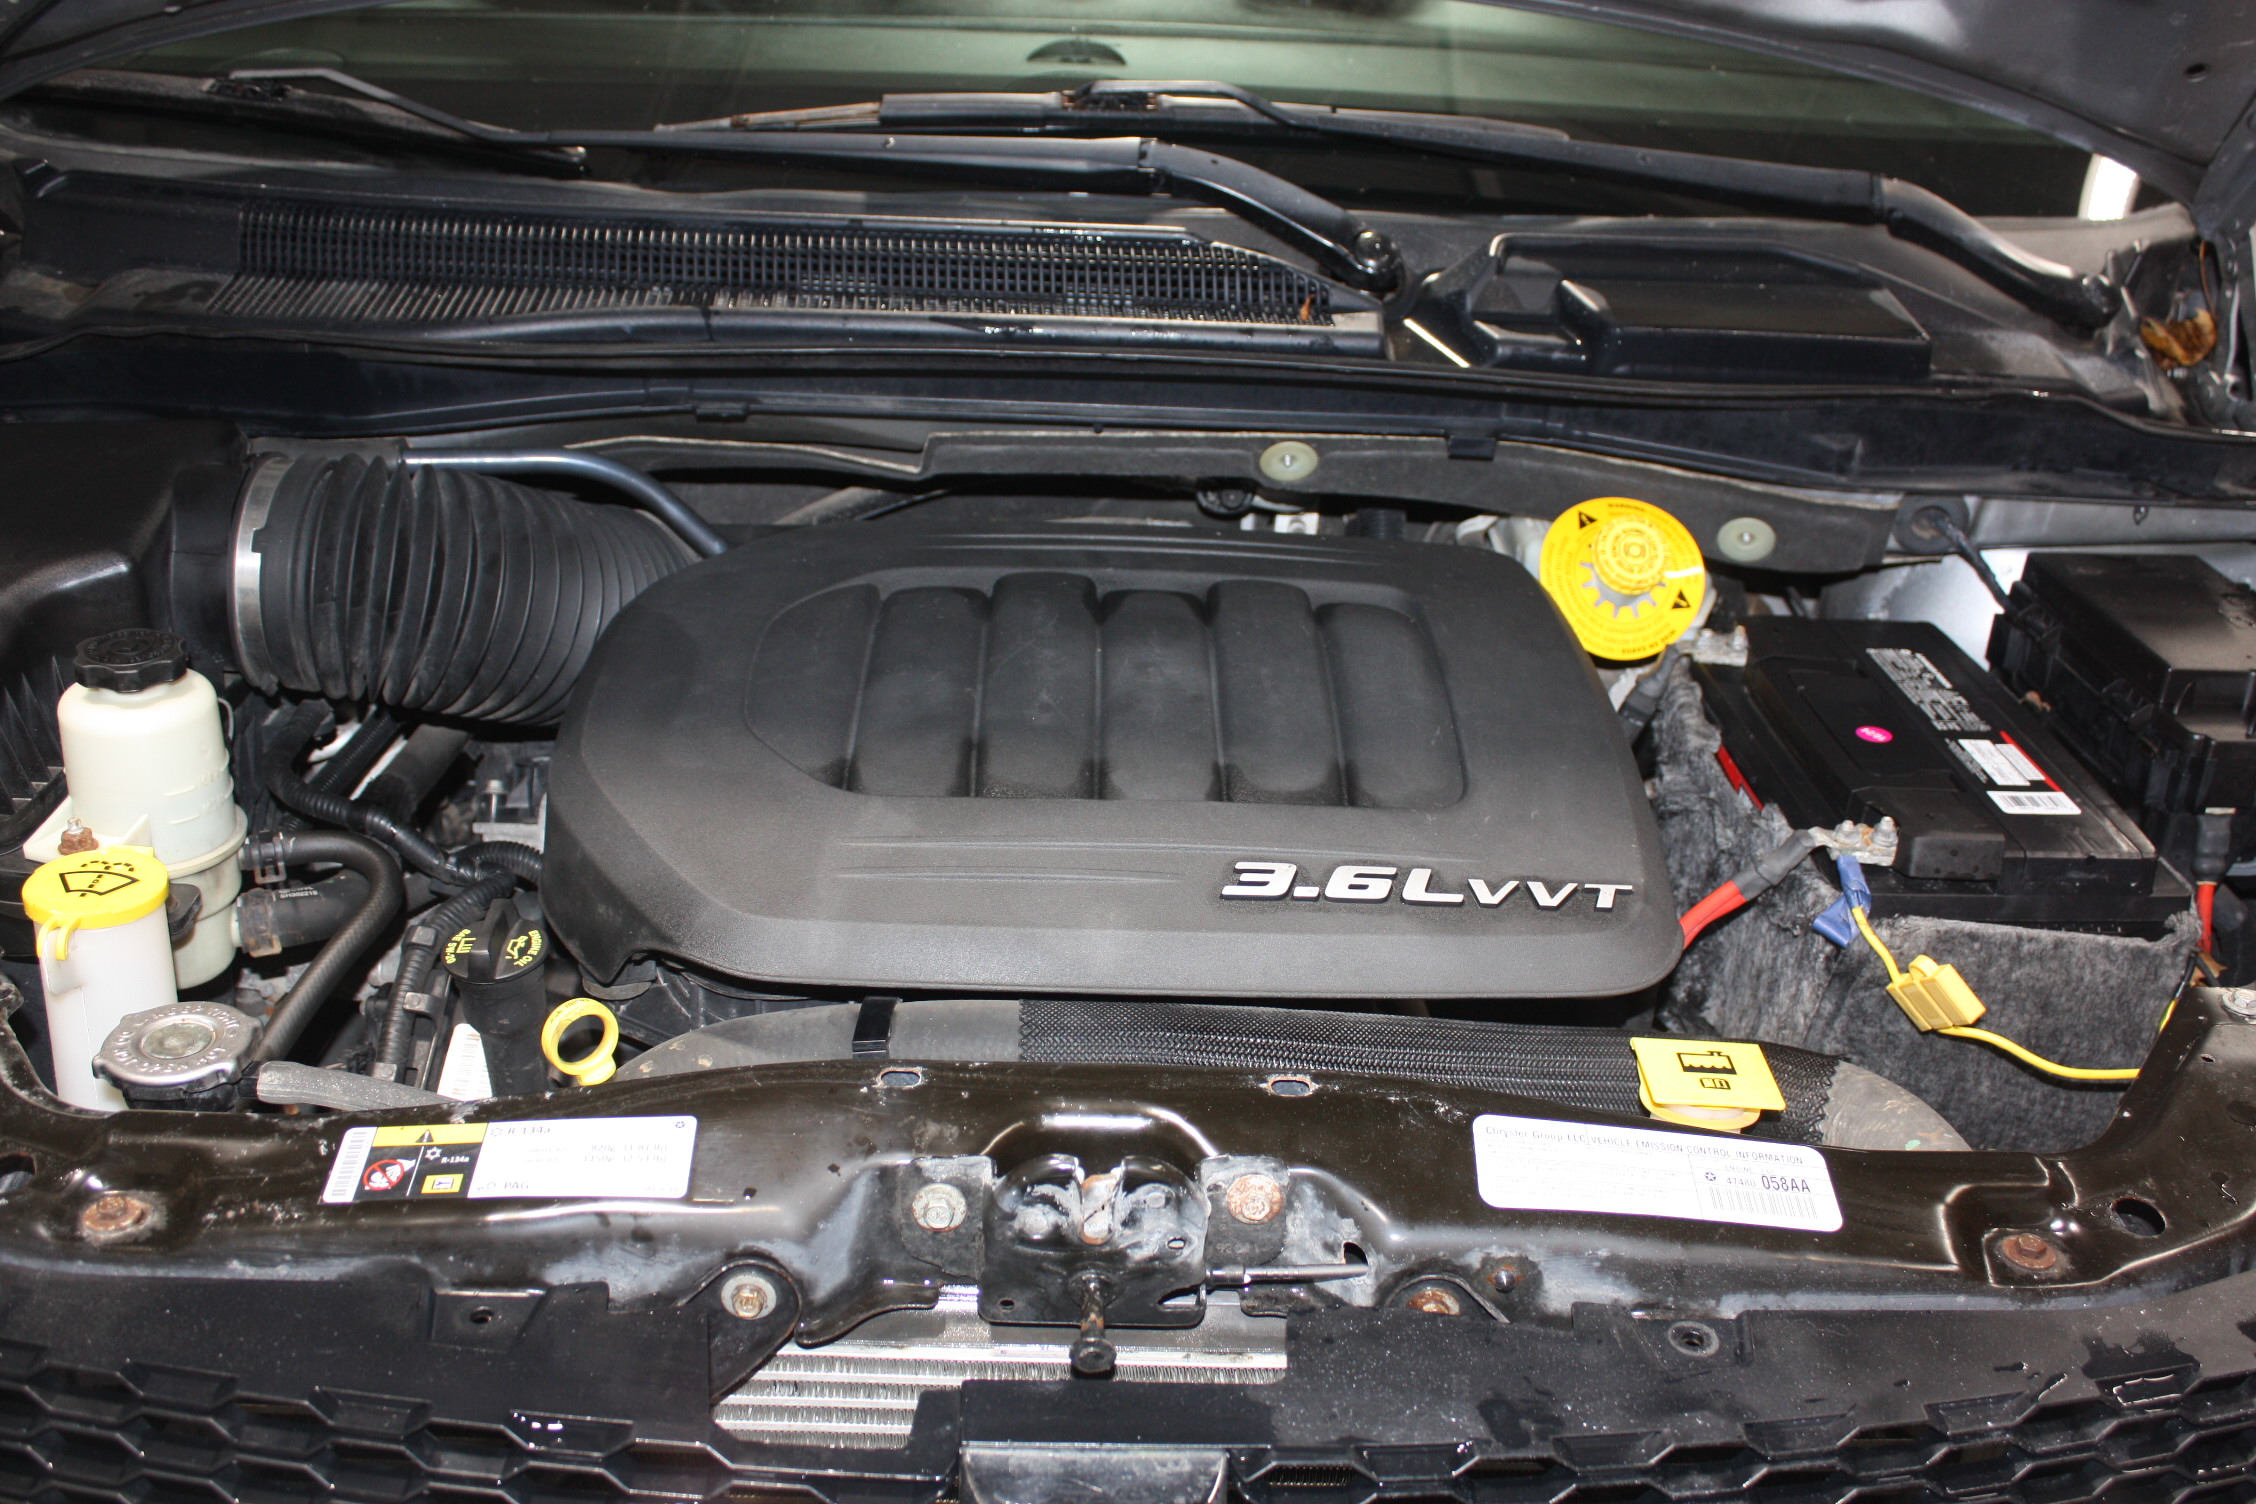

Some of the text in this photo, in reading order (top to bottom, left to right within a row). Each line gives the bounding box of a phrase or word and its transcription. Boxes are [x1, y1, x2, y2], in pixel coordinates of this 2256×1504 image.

[1221, 861, 1634, 911] 3.6L VVT
[513, 930, 542, 967] ENGINE OIL
[440, 1155, 470, 1164] R-134a
[1485, 1125, 1529, 1140] Chrysler
[1532, 1130, 1564, 1144] Group
[1567, 1134, 1587, 1145] LLC
[1590, 1136, 1631, 1148] VEHICLE
[1635, 1140, 1685, 1153] EMISSION
[1686, 1145, 1732, 1159] CONTROL
[1735, 1150, 1804, 1166] INFORMATION
[503, 1180, 529, 1191] PAG
[1761, 1174, 1812, 1194] 058AA
